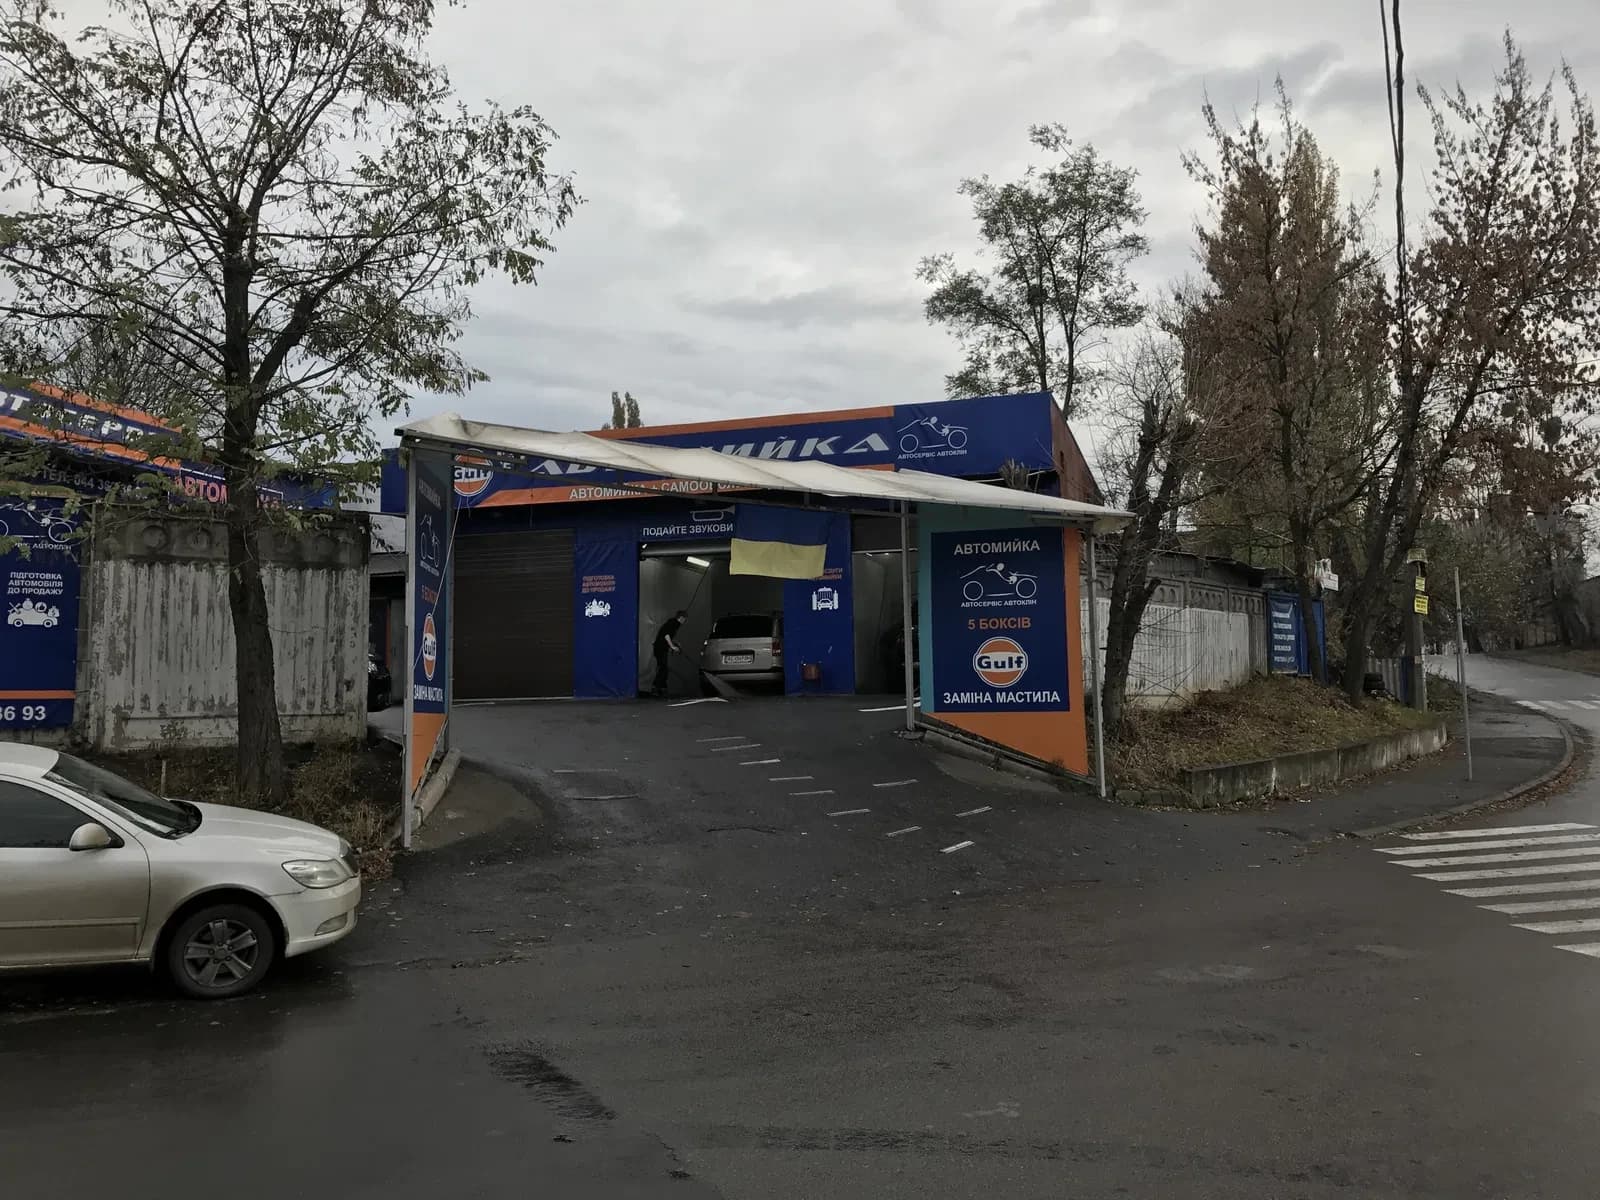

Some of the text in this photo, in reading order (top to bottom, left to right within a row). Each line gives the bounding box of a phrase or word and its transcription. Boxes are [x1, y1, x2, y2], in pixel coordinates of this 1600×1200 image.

[898, 451, 936, 459] АВТОСЕРВІС
[642, 524, 687, 537] ПОДАЙТЕ
[953, 538, 1040, 555] АВТОМИЙКА
[10, 571, 62, 580] ПІДГОТОВКА
[8, 580, 63, 588] АВТОМОБІЛЯ
[7, 587, 63, 595] ДО ПРОДАЖУ
[961, 600, 1002, 608] АВТОСЕРВІС
[967, 617, 1031, 630] 5 БОКСІВ
[977, 655, 1024, 669] Gulf
[943, 690, 1061, 704] ЗАМІНА МАСТИЛА
[0, 705, 46, 721] 6 93
